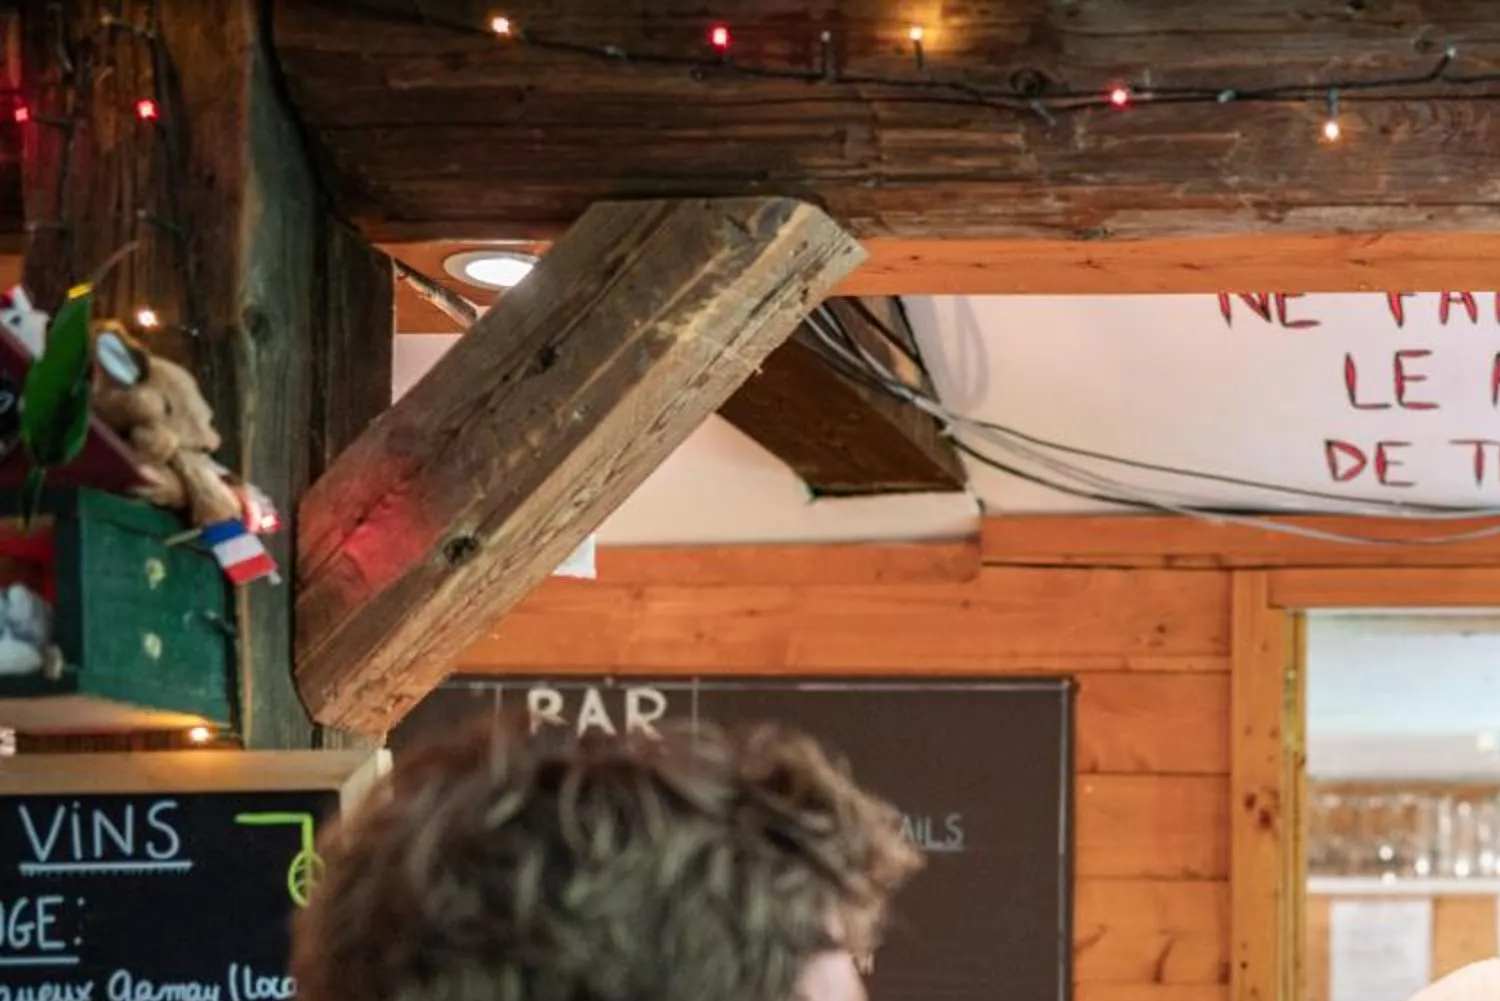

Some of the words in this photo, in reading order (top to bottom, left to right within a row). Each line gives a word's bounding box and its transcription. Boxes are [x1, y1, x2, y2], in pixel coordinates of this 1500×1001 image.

[1217, 290, 1320, 328] NE
[1345, 350, 1440, 410] LE
[1325, 439, 1418, 486] DE
